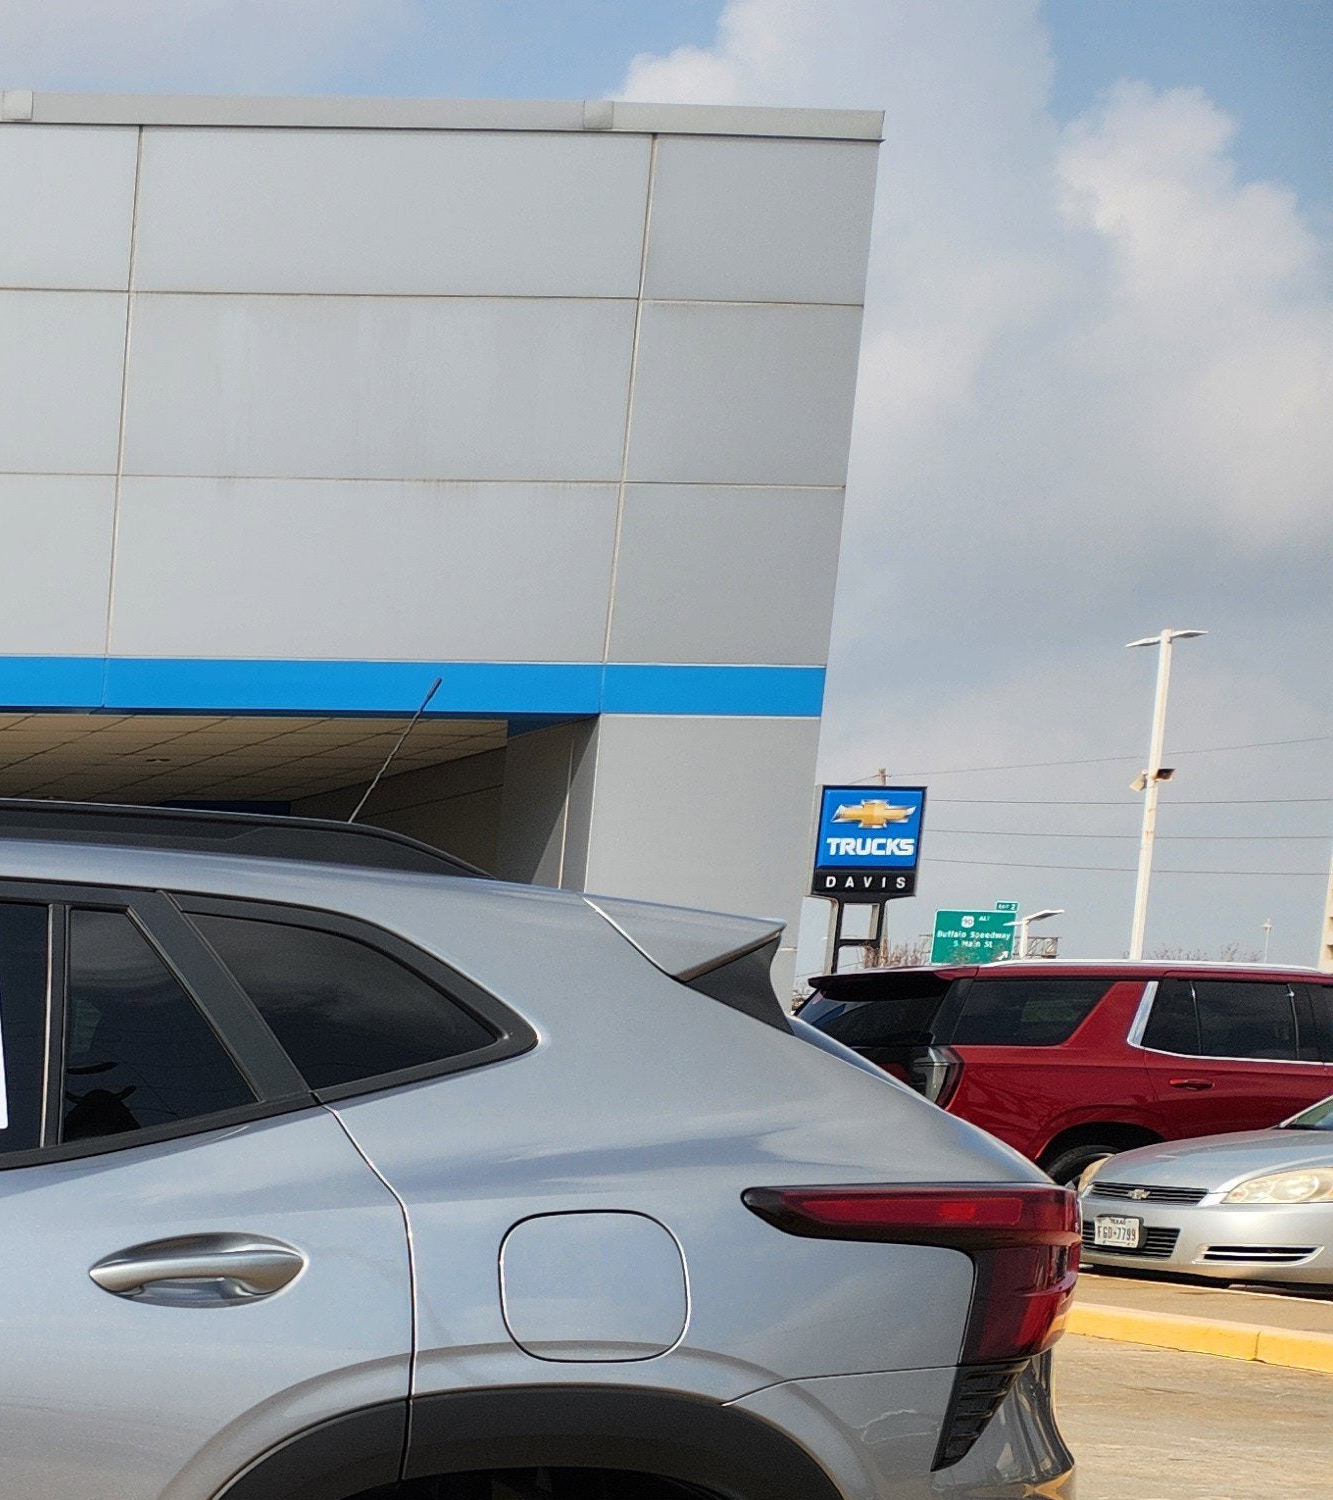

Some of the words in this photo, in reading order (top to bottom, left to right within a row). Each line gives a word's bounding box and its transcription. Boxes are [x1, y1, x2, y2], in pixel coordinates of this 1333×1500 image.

[826, 837, 915, 856] TRUCKS
[825, 876, 906, 889] DAVIS
[936, 930, 967, 938] Buffalo
[970, 931, 1012, 941] Speedway
[953, 940, 959, 948] S
[961, 940, 981, 948] Main
[983, 940, 993, 948] St
